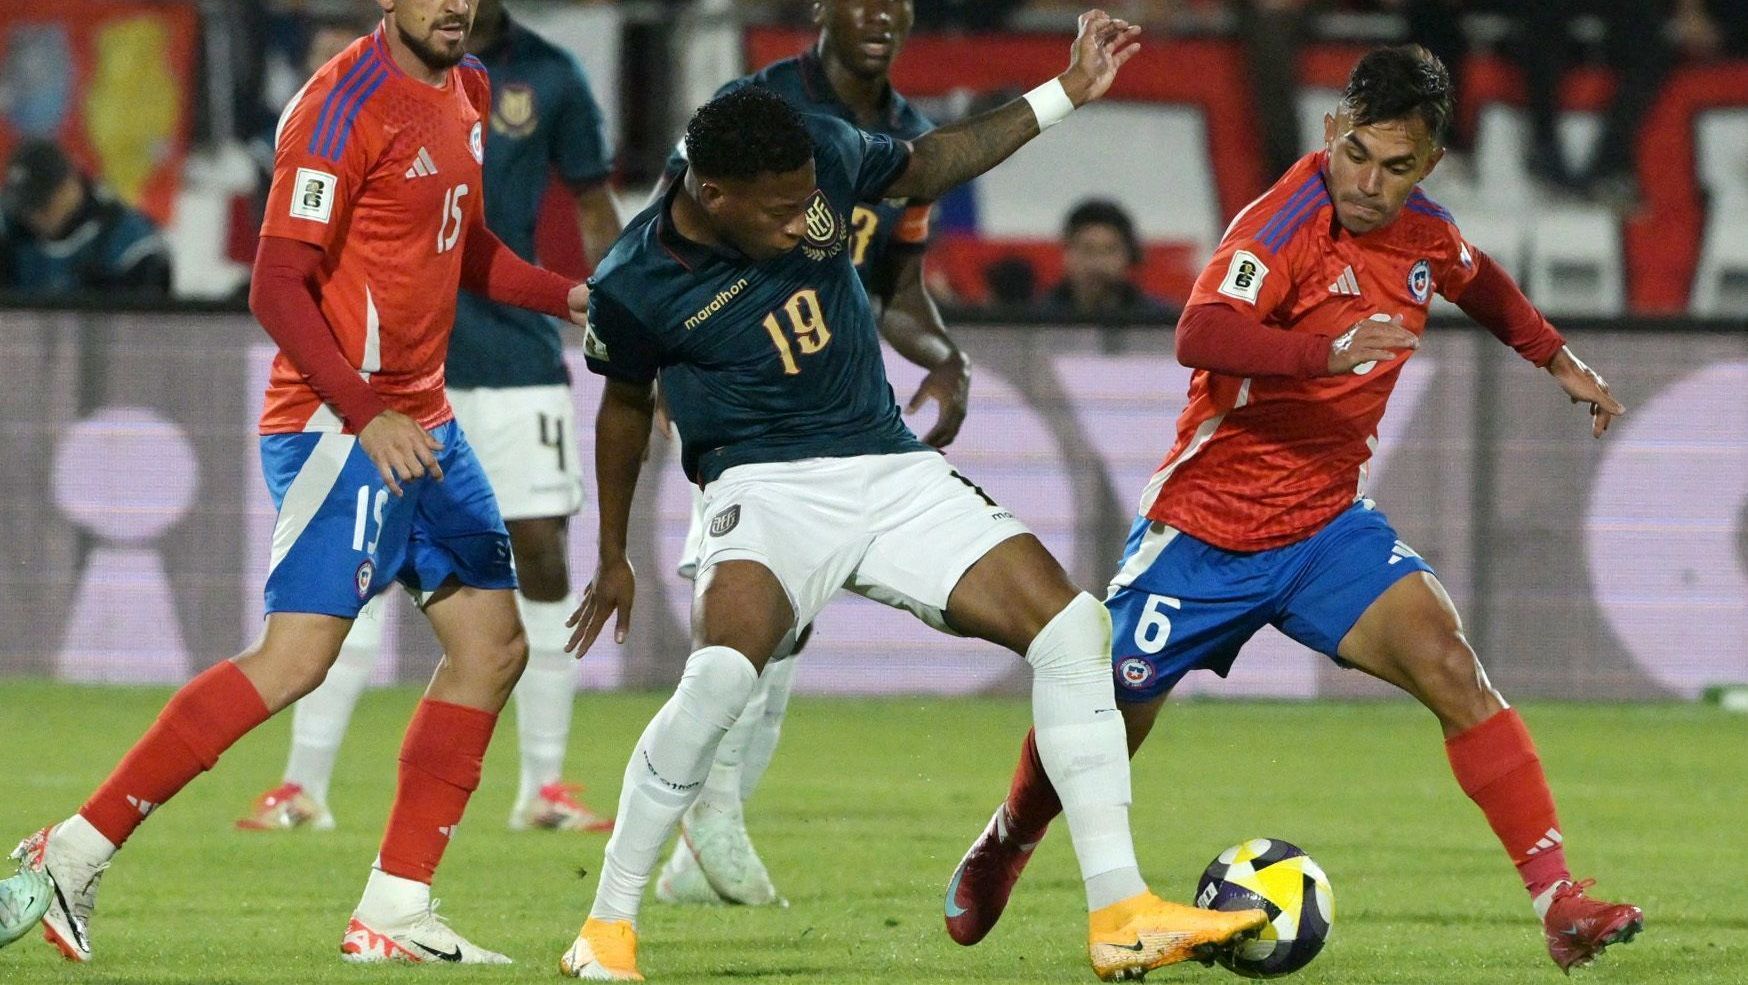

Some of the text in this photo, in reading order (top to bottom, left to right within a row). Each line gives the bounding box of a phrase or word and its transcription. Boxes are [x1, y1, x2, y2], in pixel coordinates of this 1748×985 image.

[437, 184, 468, 253] 15
[684, 278, 749, 331] marathon
[763, 289, 833, 374] 19
[538, 411, 567, 472] 4
[1133, 593, 1182, 655] 6
